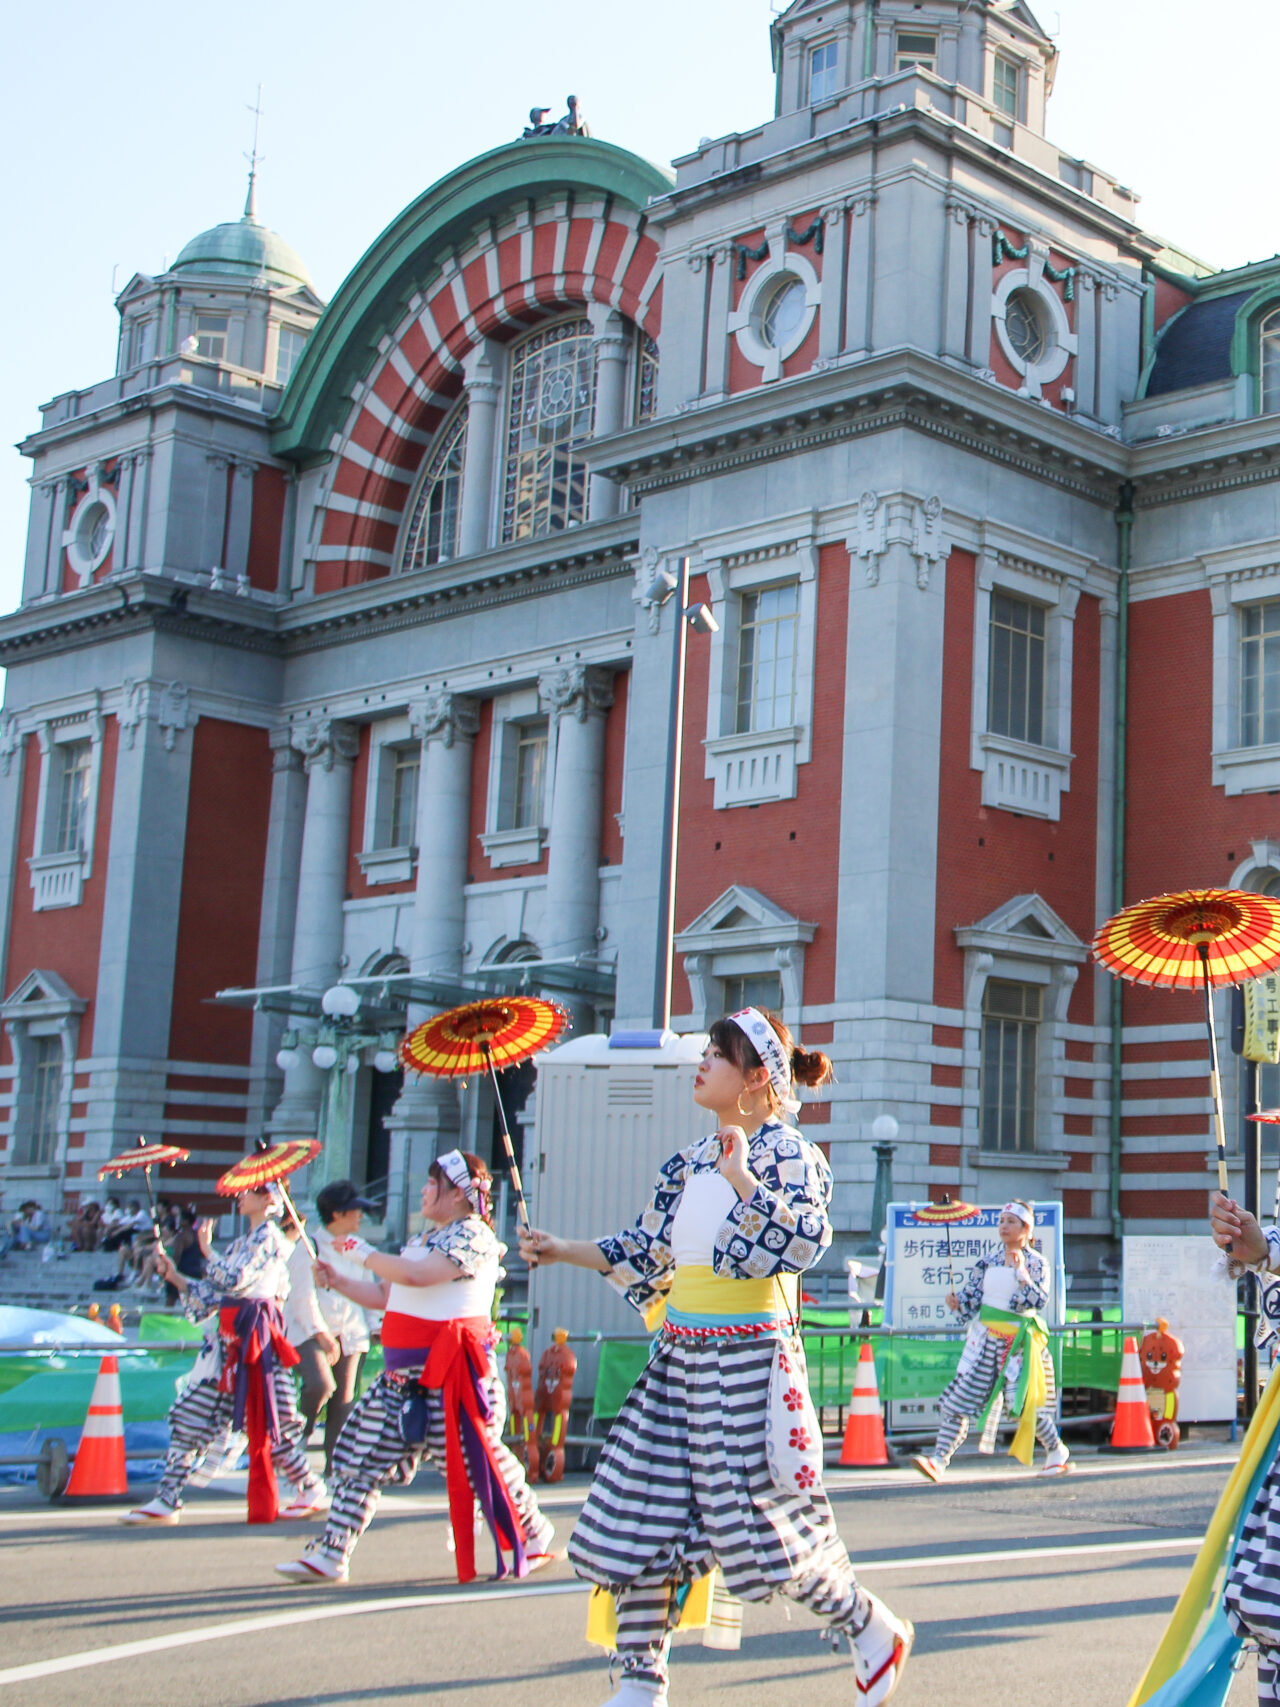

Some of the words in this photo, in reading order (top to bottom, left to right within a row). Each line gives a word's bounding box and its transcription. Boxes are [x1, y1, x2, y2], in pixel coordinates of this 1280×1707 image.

[904, 1240, 1043, 1258] 歩行者空間化
